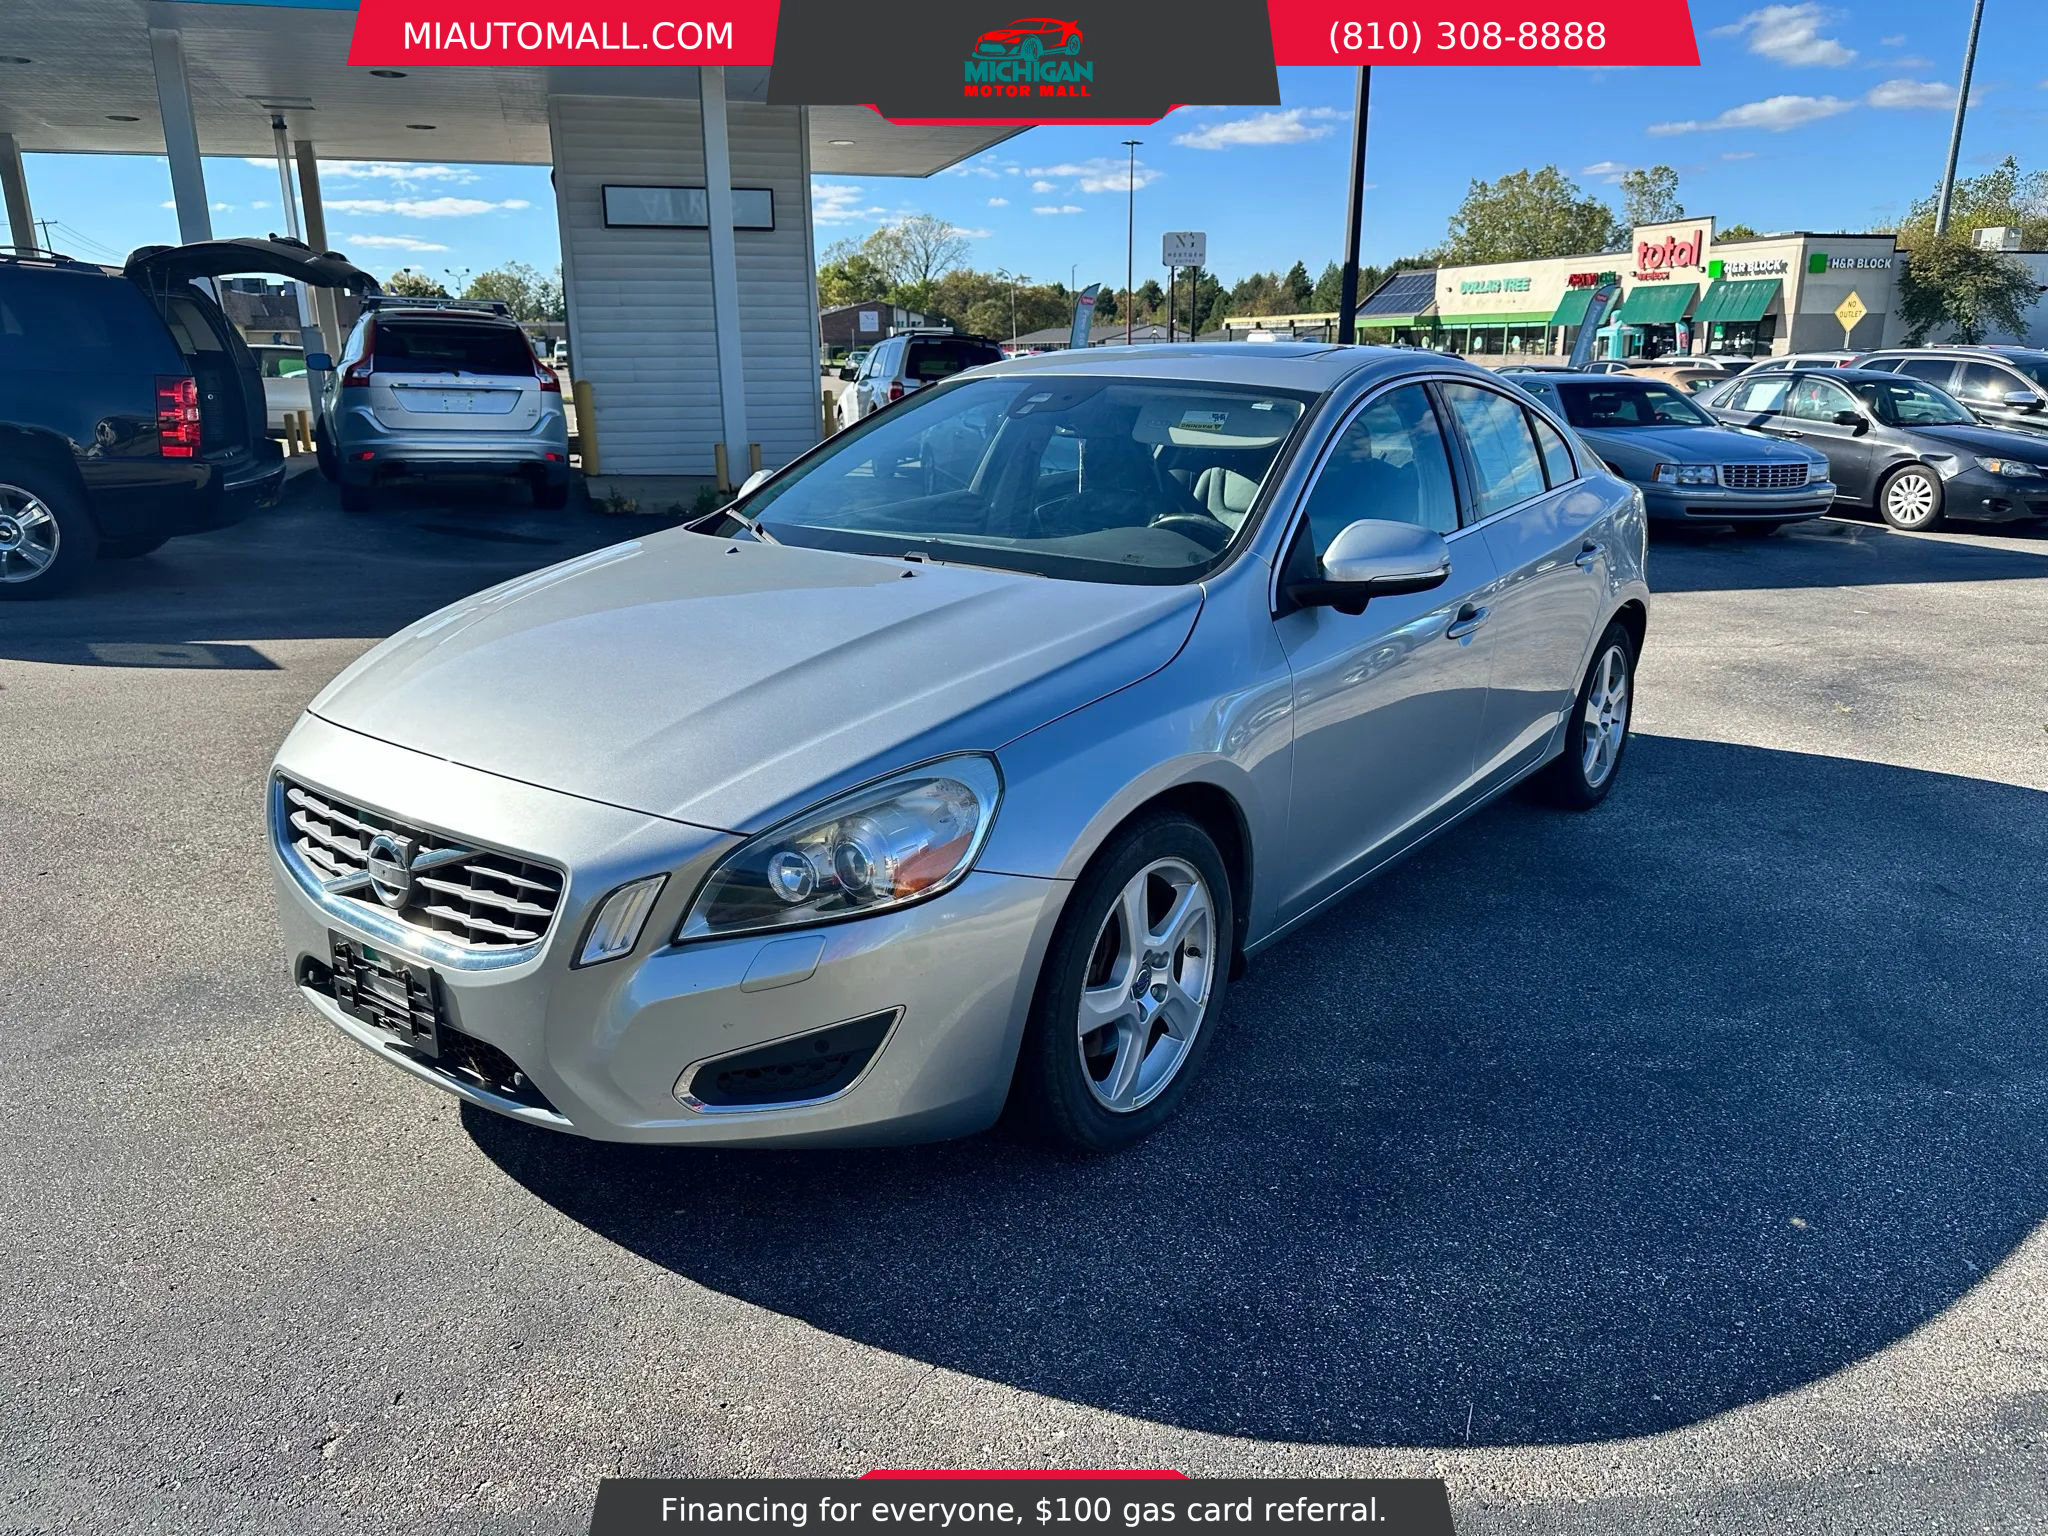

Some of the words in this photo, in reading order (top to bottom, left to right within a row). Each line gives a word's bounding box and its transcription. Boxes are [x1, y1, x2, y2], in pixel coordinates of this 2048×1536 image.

[1637, 229, 1703, 270] total
[1724, 262, 1746, 273] H&R
[1747, 259, 1783, 271] BLOCK
[1831, 258, 1854, 269] H&R
[1857, 258, 1892, 269] BLOCK
[1460, 280, 1501, 295] DOLLAR
[1503, 277, 1531, 292] TREE
[1847, 300, 1857, 308] NO
[1838, 310, 1863, 319] OUTLET
